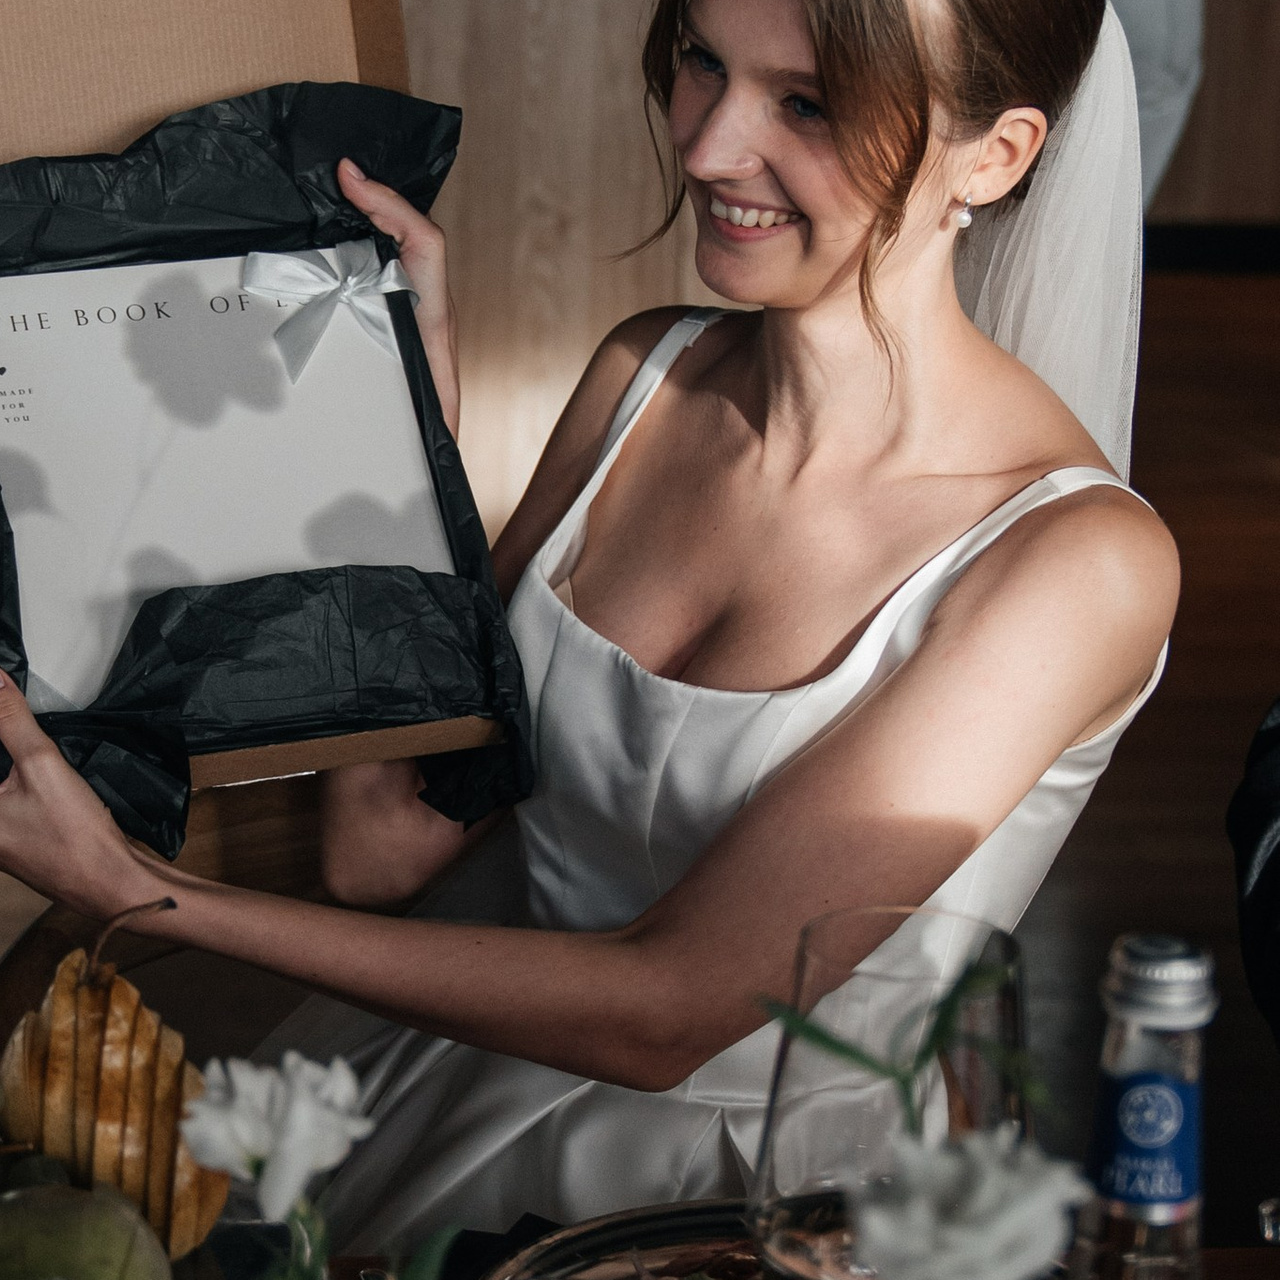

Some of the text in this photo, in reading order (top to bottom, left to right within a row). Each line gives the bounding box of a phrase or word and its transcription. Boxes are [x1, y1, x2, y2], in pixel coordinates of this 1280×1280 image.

[74, 301, 172, 326] BOOK
[210, 294, 250, 314] OF
[1, 402, 26, 411] FOR
[4, 414, 31, 424] YOU
